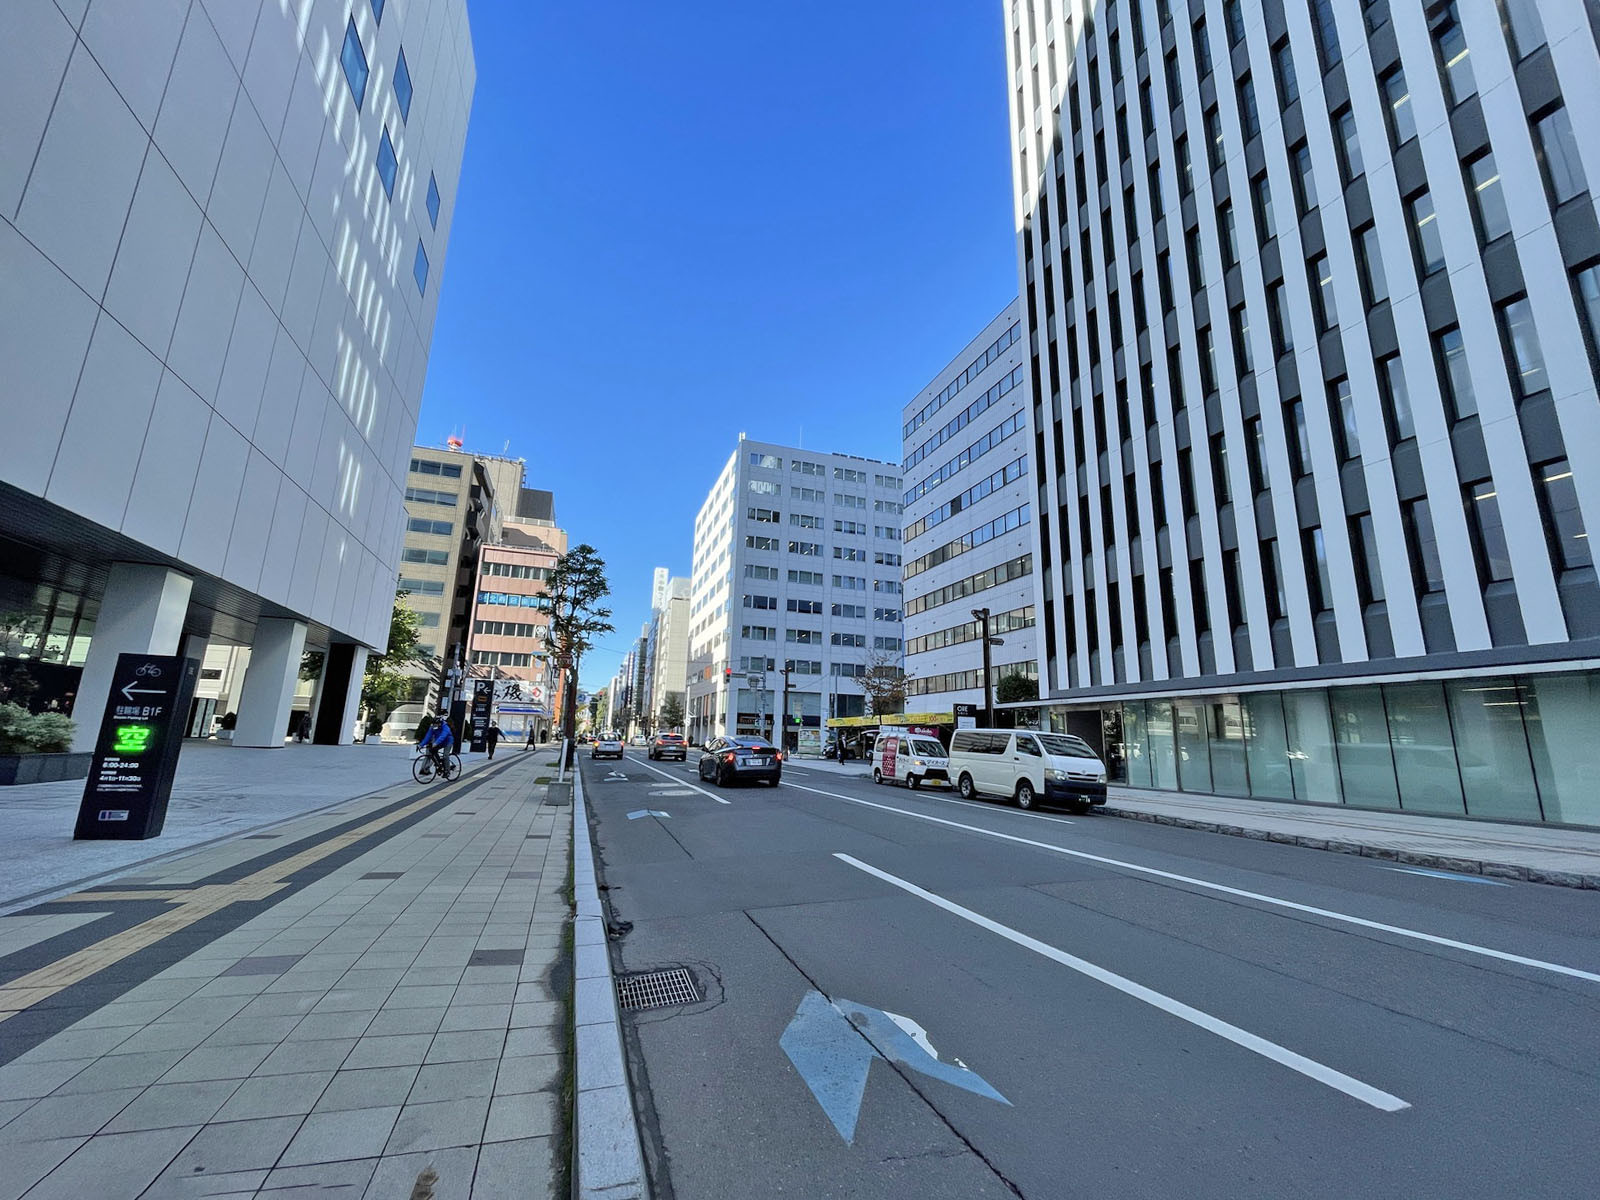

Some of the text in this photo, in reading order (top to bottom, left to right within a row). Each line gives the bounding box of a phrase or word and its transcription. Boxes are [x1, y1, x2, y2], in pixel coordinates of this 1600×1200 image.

[477, 683, 486, 692] P
[142, 706, 163, 716] B1F
[114, 725, 151, 751] 空
